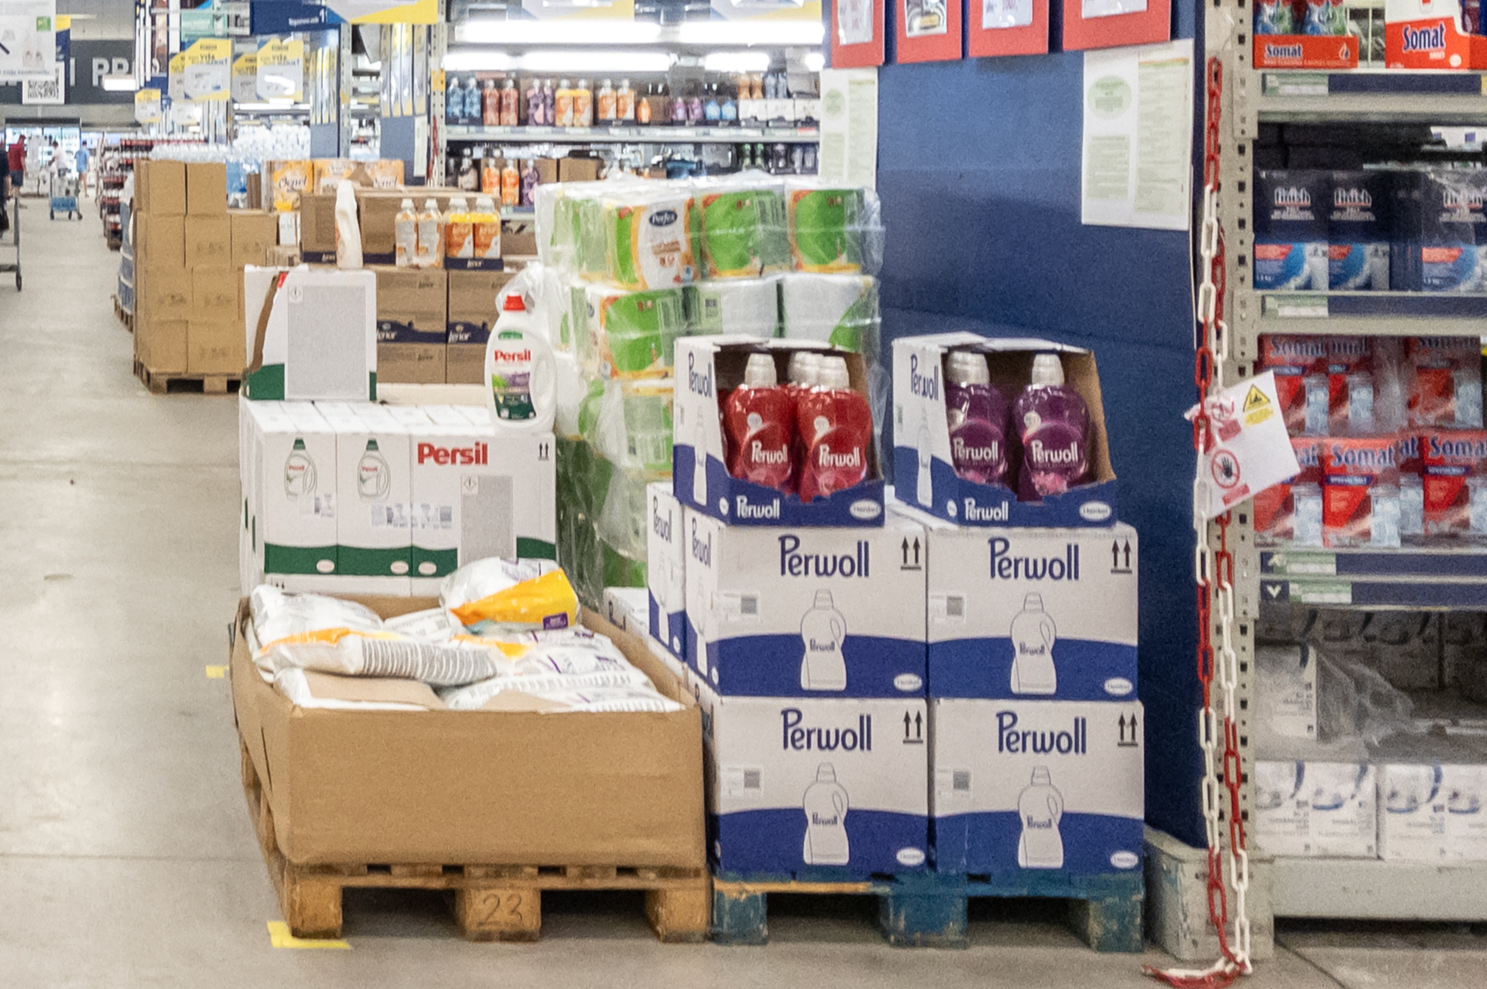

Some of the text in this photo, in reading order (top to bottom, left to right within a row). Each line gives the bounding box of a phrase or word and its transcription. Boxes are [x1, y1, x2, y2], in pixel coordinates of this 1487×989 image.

[1402, 23, 1446, 52] Somat
[1265, 44, 1303, 59] Somat
[494, 348, 532, 362] Persil
[688, 351, 712, 398] Perwoll
[911, 353, 939, 401] Perwoll
[418, 441, 488, 466] Persil
[751, 440, 788, 464] Perwoll
[818, 444, 861, 467] Perwoll
[954, 437, 999, 461] Perwoll
[1031, 440, 1079, 464] Perwoll
[1332, 444, 1395, 467] Somat
[736, 495, 780, 518] Perwoll
[964, 497, 1009, 521] Perwoll
[778, 534, 870, 578] Perwoll
[988, 537, 1080, 581] Perwoll
[810, 639, 836, 653] Perwoll
[1019, 642, 1045, 656] Perwoll
[781, 708, 872, 752] Perwoll
[996, 710, 1087, 755] Perwoll
